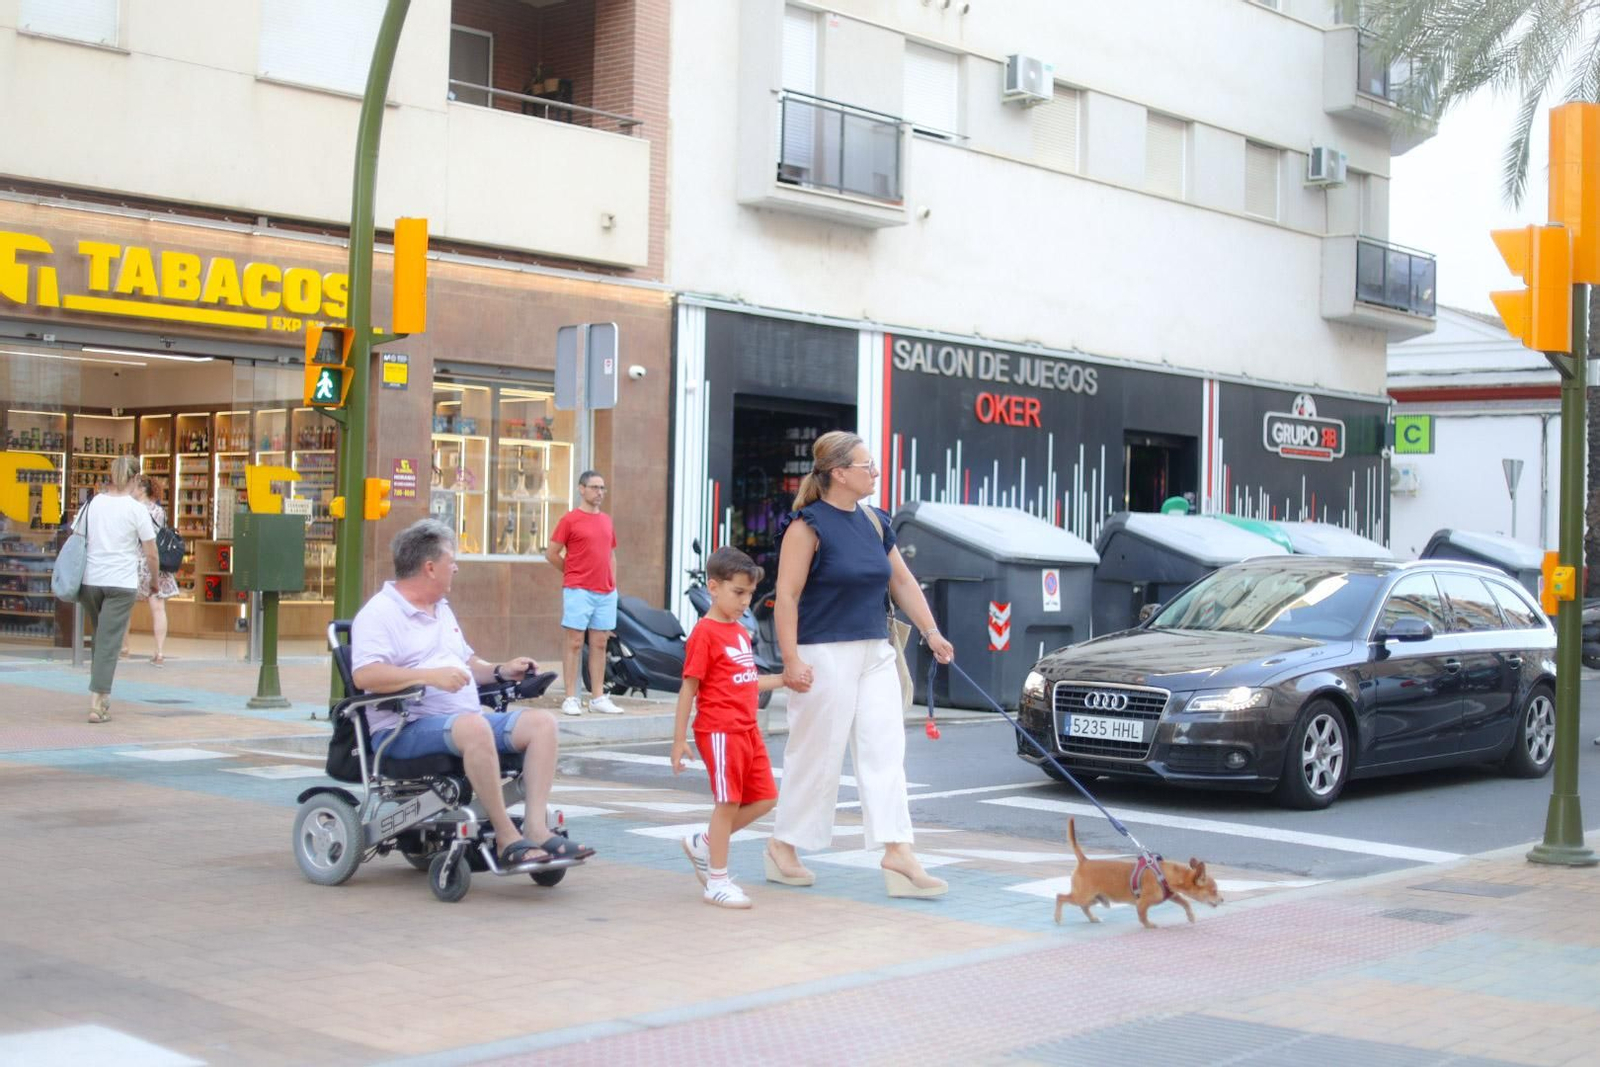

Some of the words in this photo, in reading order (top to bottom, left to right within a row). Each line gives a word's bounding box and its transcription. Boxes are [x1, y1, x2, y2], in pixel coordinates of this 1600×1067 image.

[78, 240, 348, 318] TABACOS
[893, 339, 974, 378] SALON
[978, 351, 1010, 382] DE
[1013, 357, 1098, 395] JUEGOS
[975, 391, 1041, 427] OKER
[1272, 422, 1318, 446] GRUPO
[1403, 424, 1422, 444] C
[732, 668, 759, 683] adid
[1073, 718, 1107, 736] 5235
[1112, 721, 1139, 739] HHL
